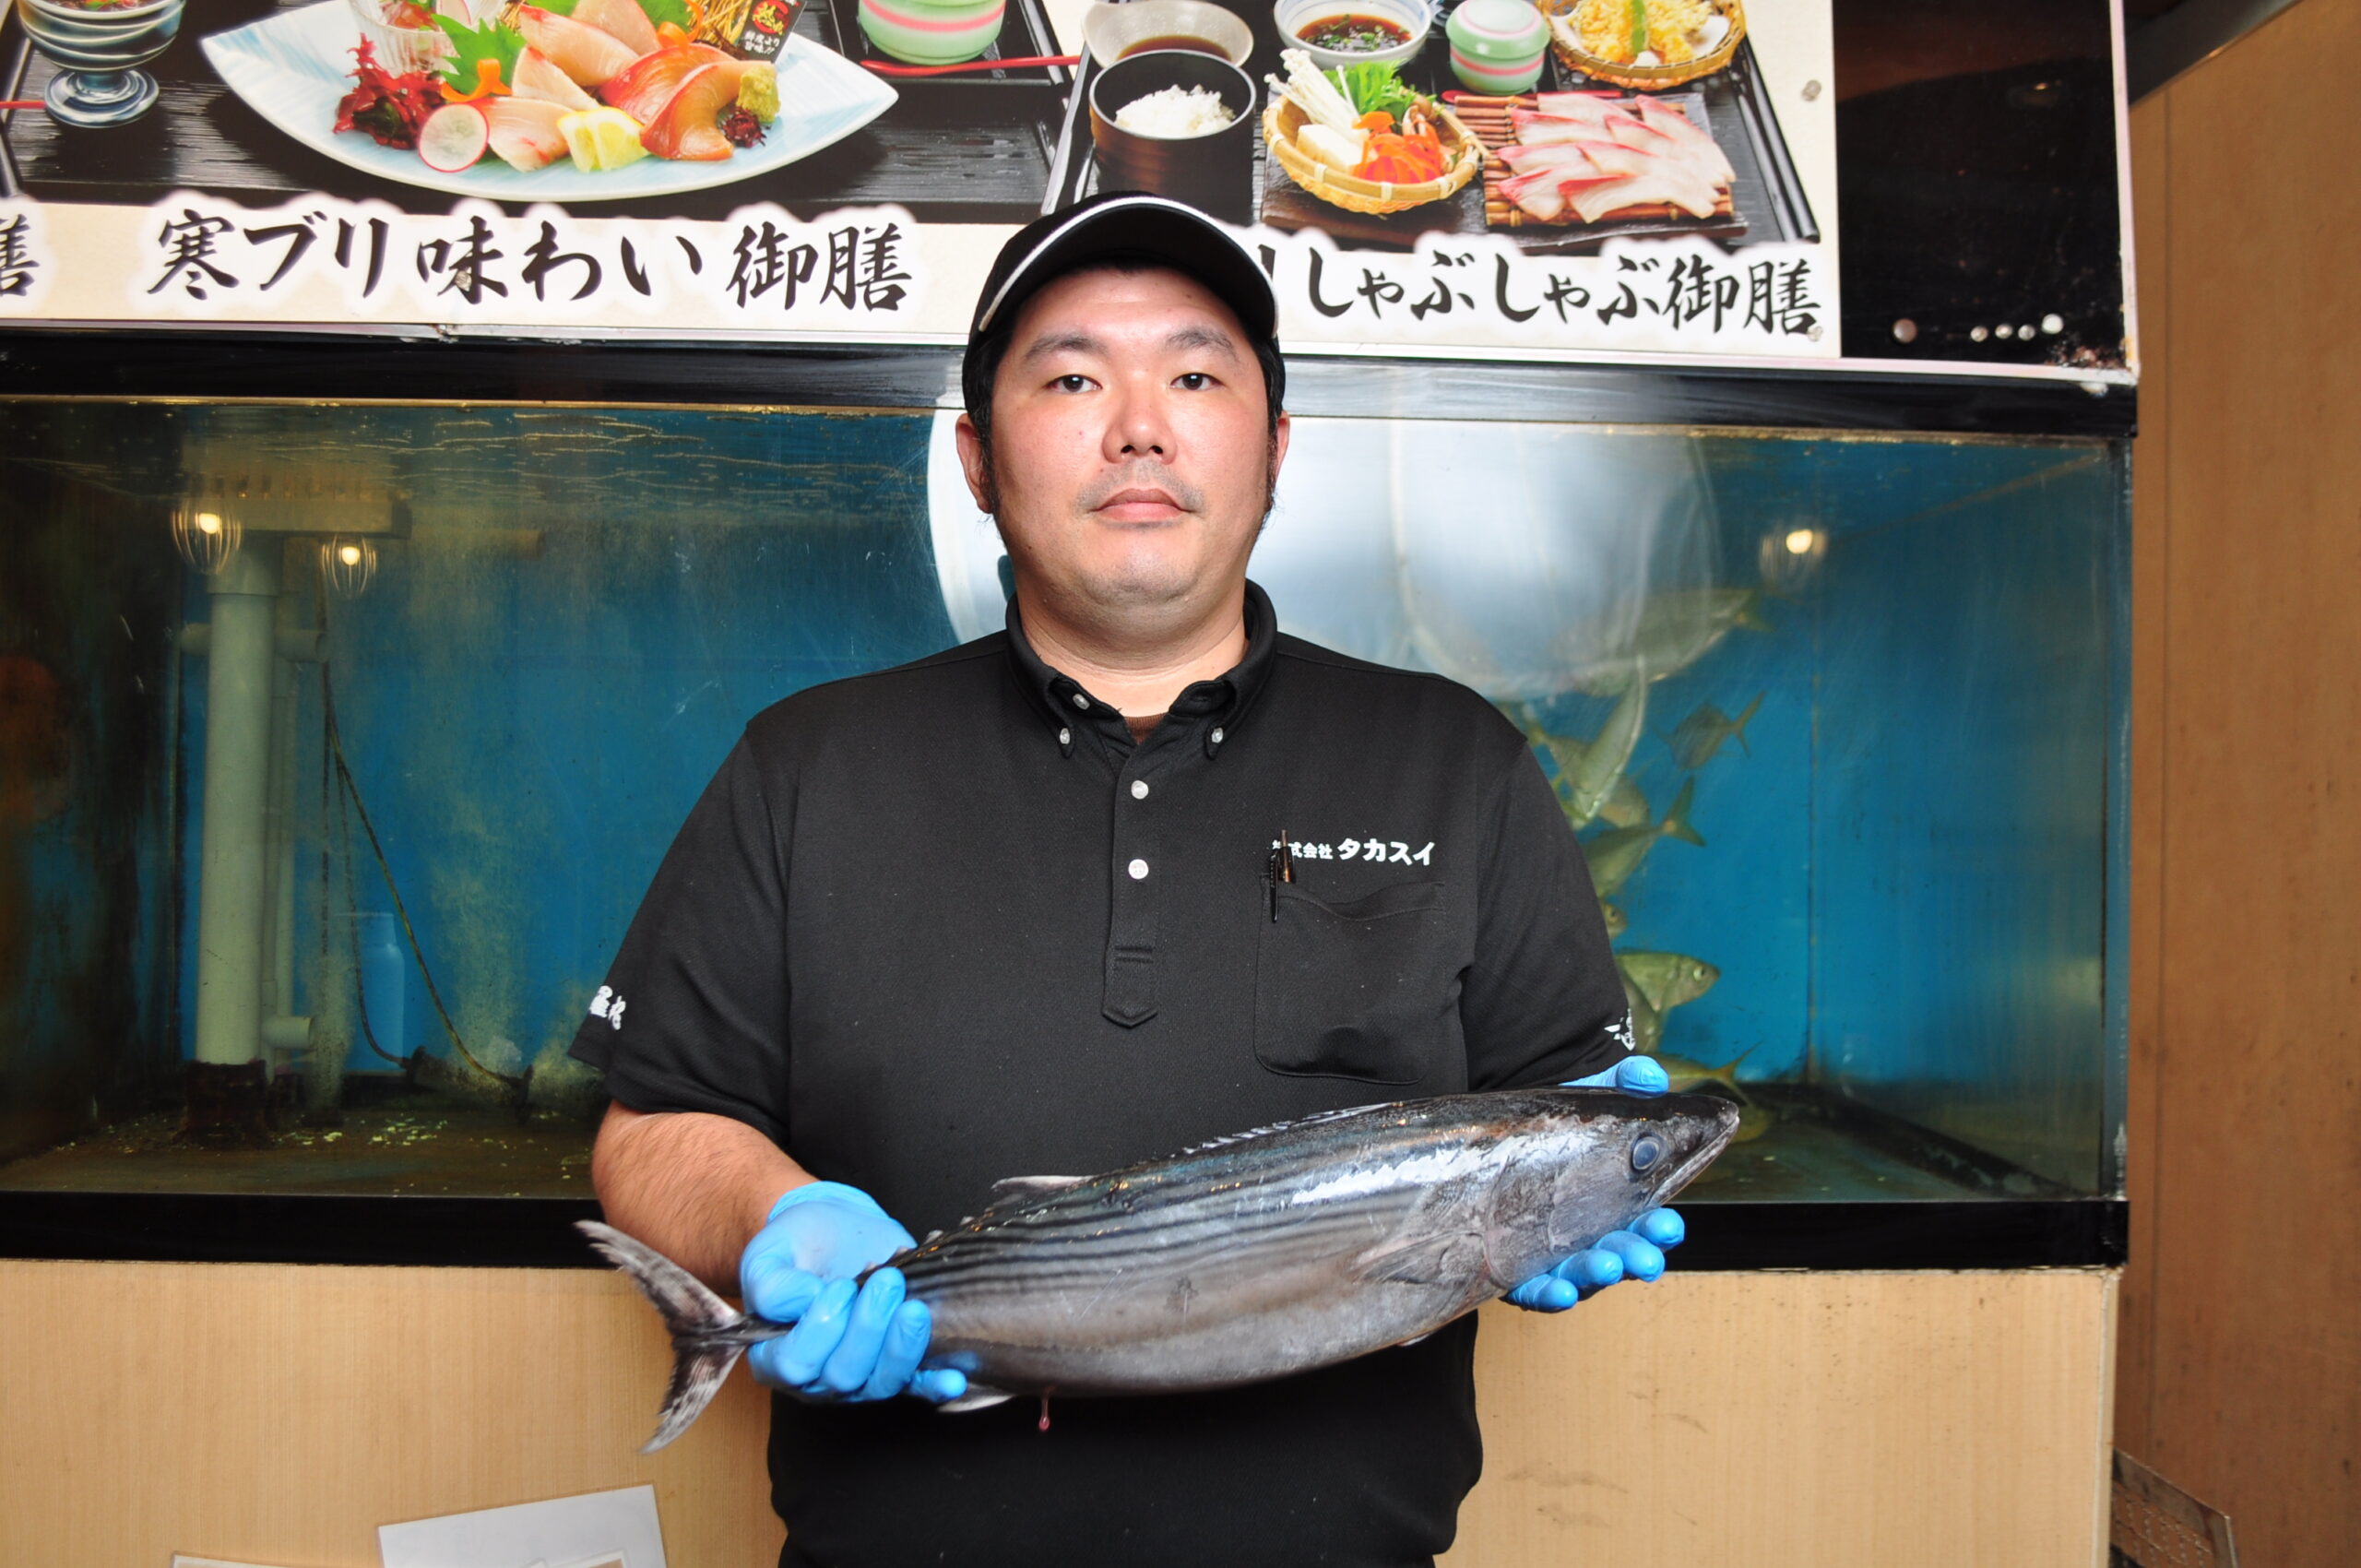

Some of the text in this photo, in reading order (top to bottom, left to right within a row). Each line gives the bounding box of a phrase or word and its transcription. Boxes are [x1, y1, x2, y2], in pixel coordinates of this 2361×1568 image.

[148, 209, 913, 311] 寒ブリ味わい御膳
[1257, 244, 1821, 335] しゃぶしゃぶ御膳
[1337, 837, 1435, 866] タカスイ
